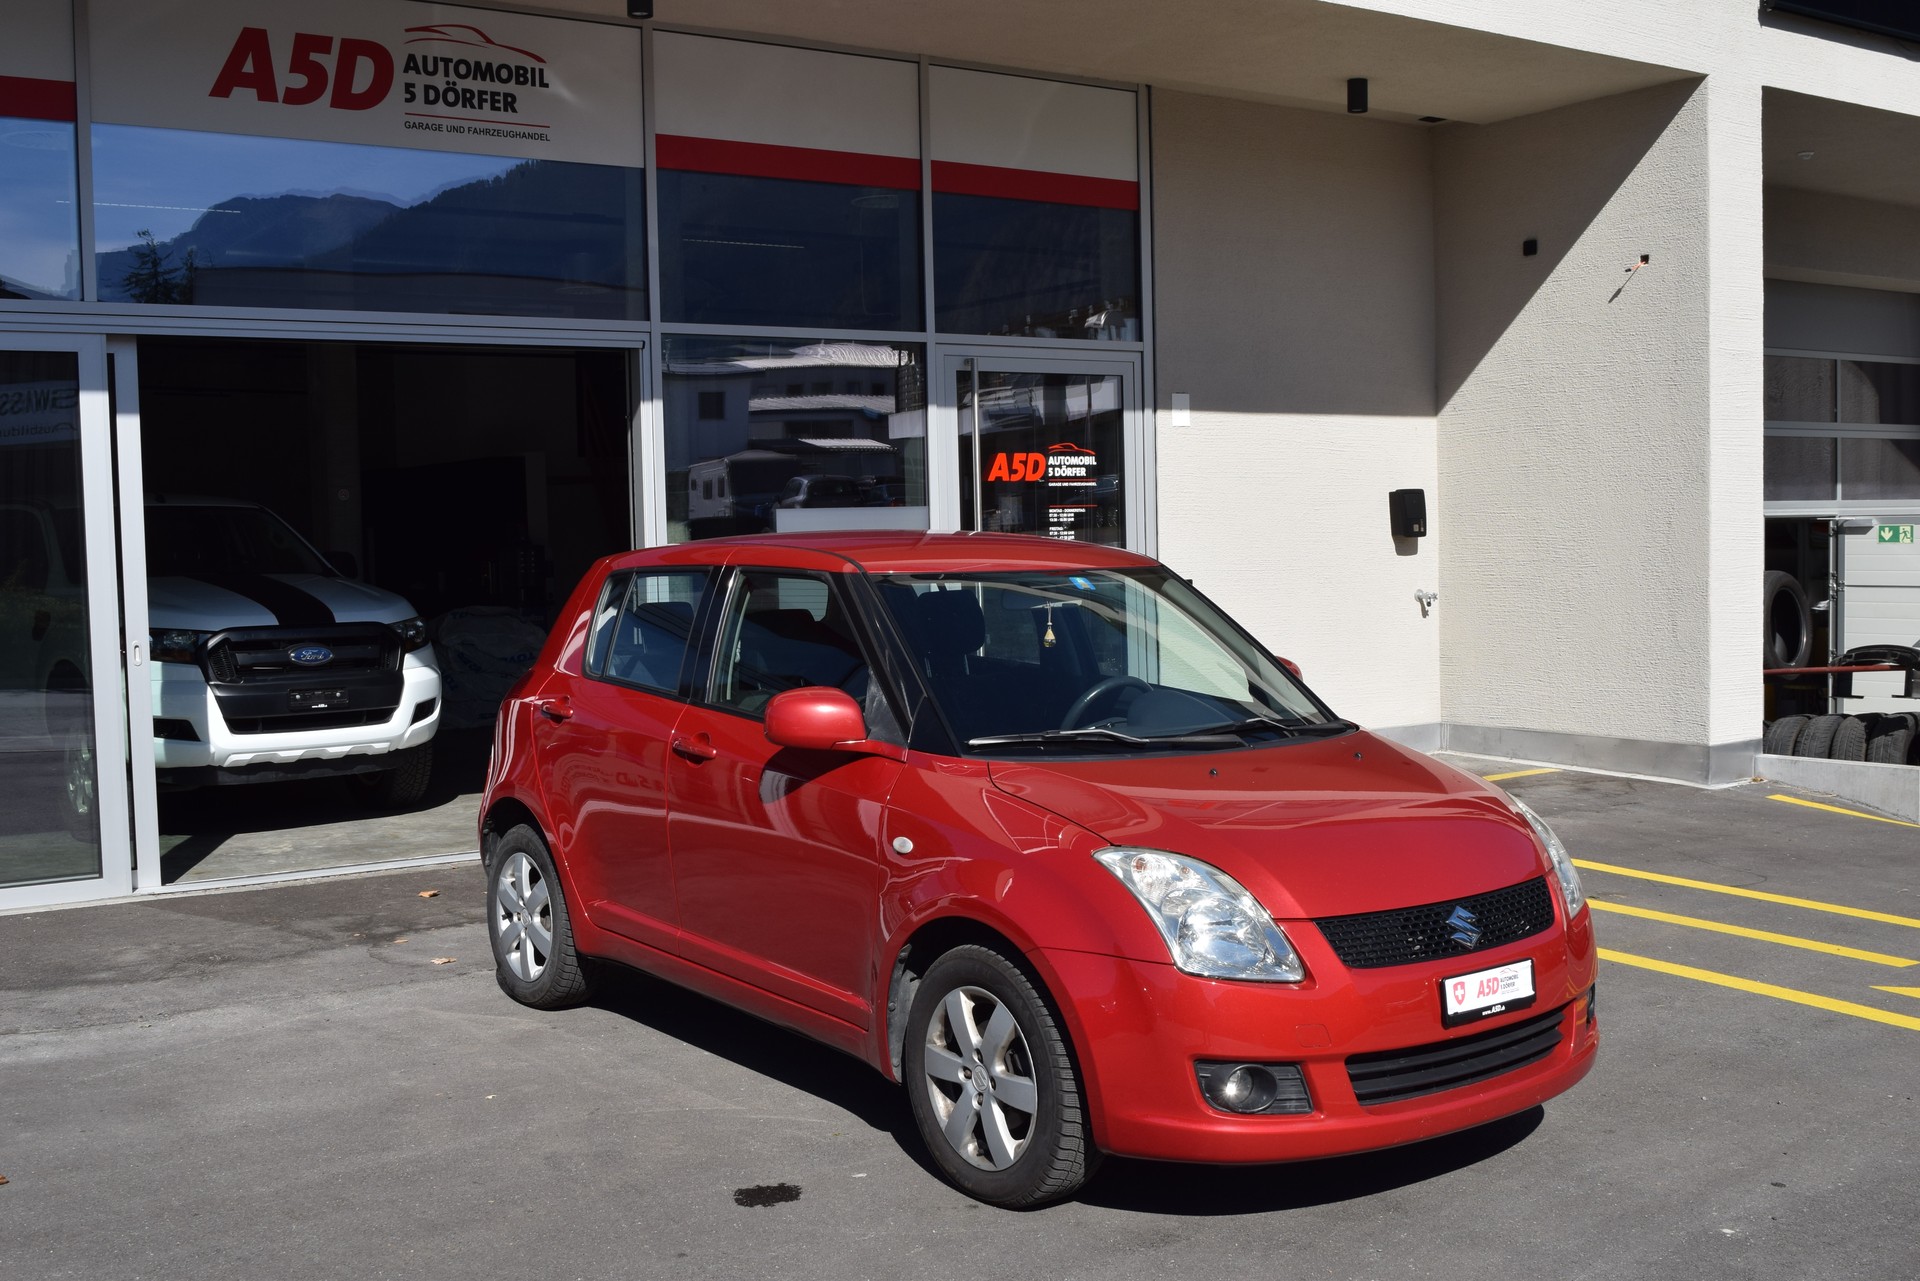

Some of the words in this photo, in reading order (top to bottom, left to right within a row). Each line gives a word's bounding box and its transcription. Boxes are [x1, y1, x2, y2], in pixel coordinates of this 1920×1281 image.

[208, 26, 395, 111] A5D
[403, 53, 550, 88] AUTOMOBIL
[404, 82, 417, 103] 5
[423, 80, 518, 113] DÖRFER
[404, 120, 444, 132] GARAGE
[446, 125, 466, 134] UND
[467, 126, 551, 142] FAHRZEUGHANDEL
[988, 452, 1047, 481] A5D
[1048, 456, 1097, 465] AUTOMOBIL
[1048, 467, 1053, 476] 5
[1054, 465, 1086, 476] DÖRFER
[1477, 977, 1500, 998] A5D
